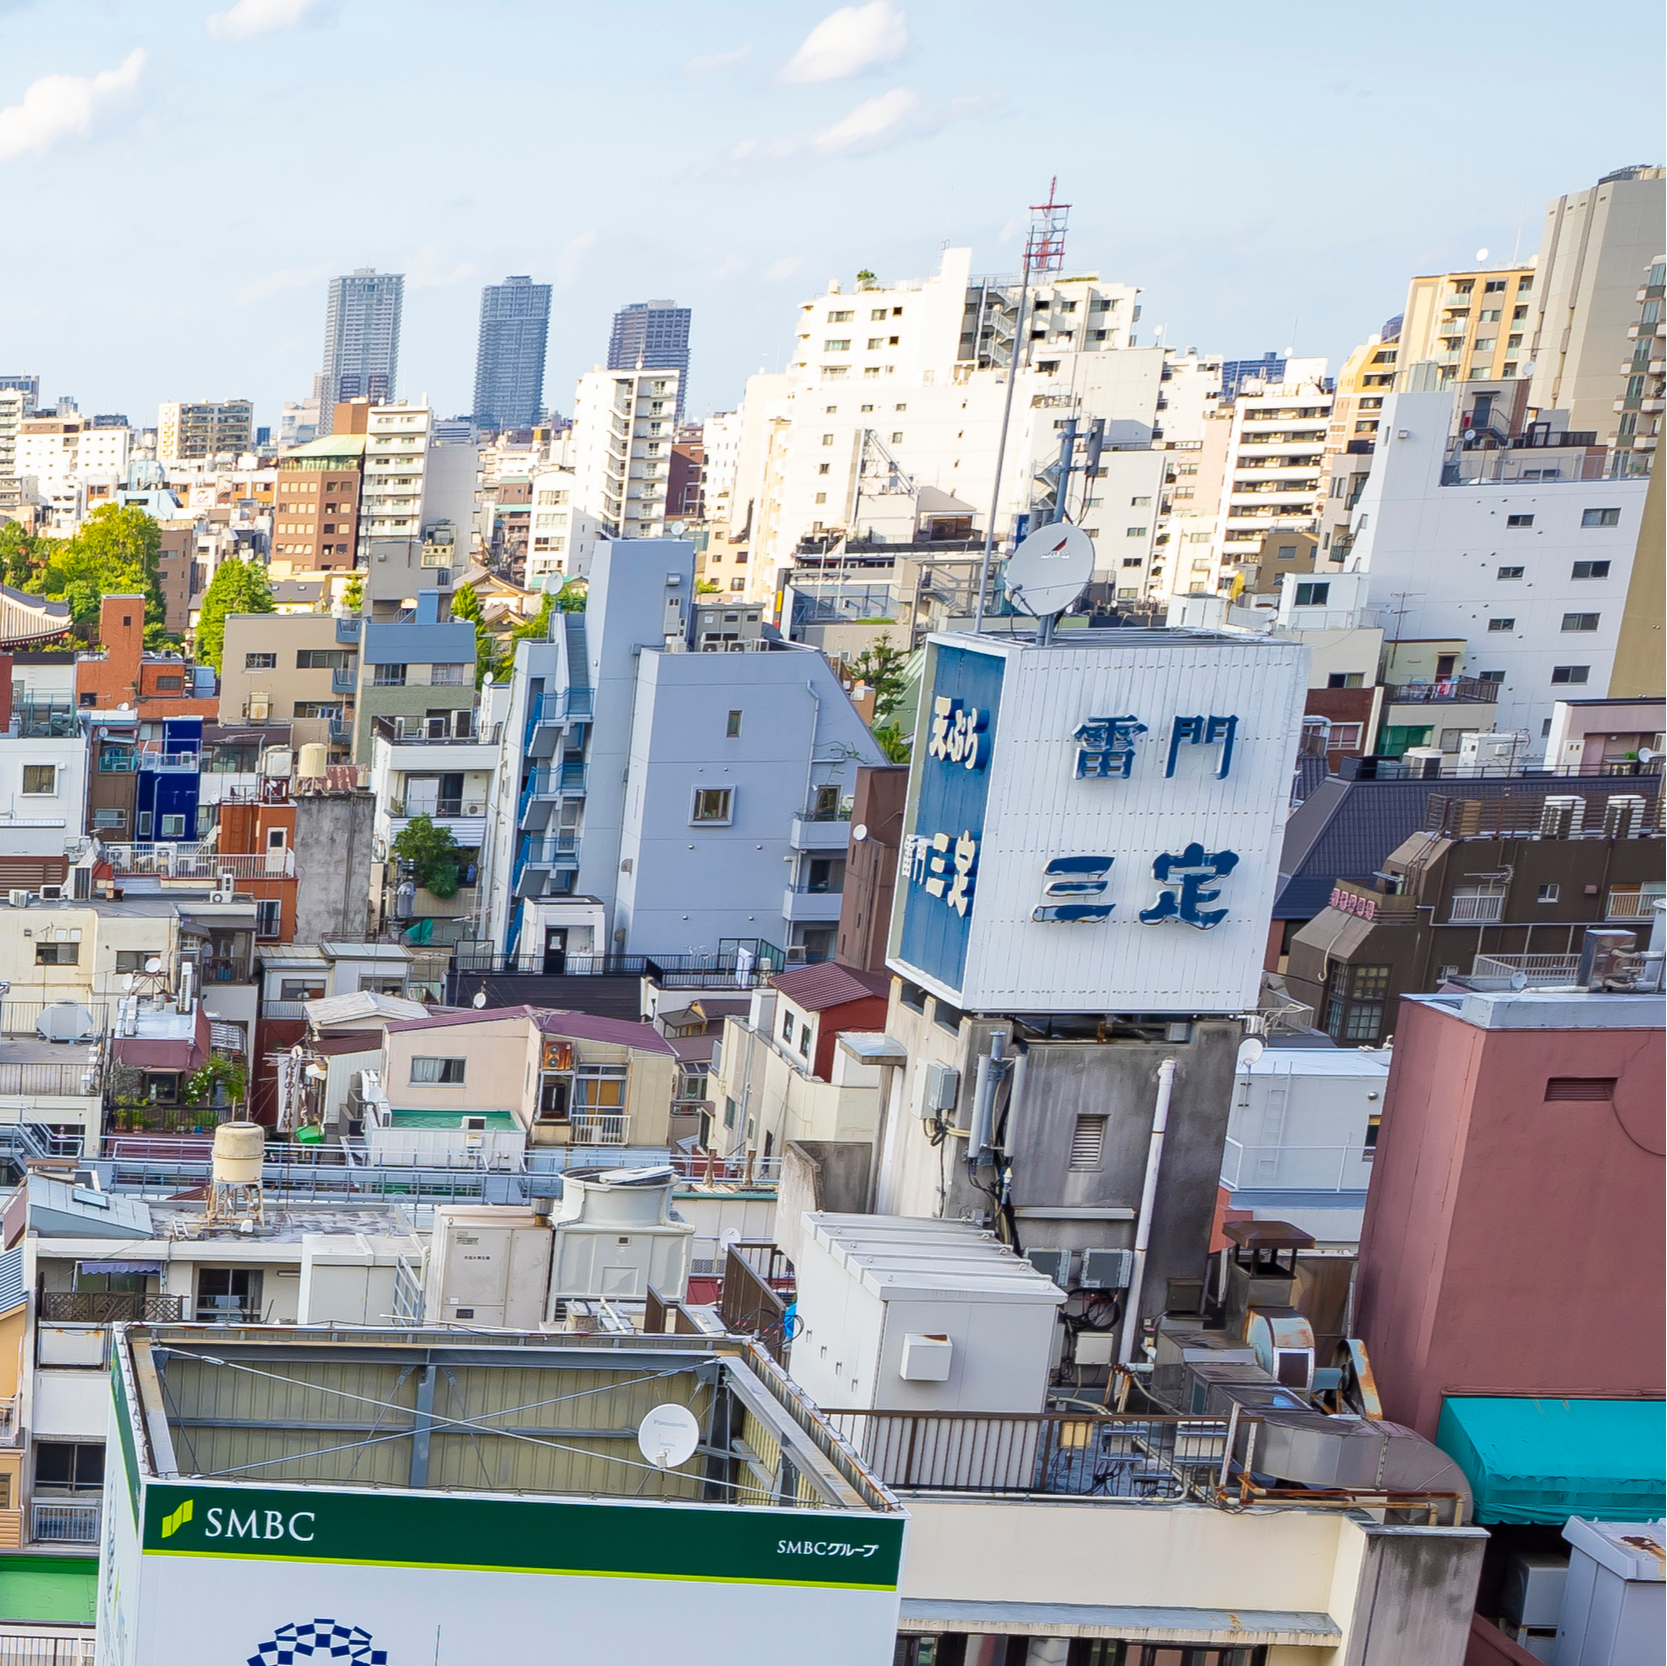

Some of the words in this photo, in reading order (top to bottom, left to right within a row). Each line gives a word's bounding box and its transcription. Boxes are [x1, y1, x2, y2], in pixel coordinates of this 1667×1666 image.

[931, 696, 978, 771] 天ぷら
[1071, 713, 1238, 781] 雷門
[1031, 842, 1240, 929] 三定
[204, 1507, 316, 1542] SMBC
[776, 1539, 880, 1558] SMBCグループ
